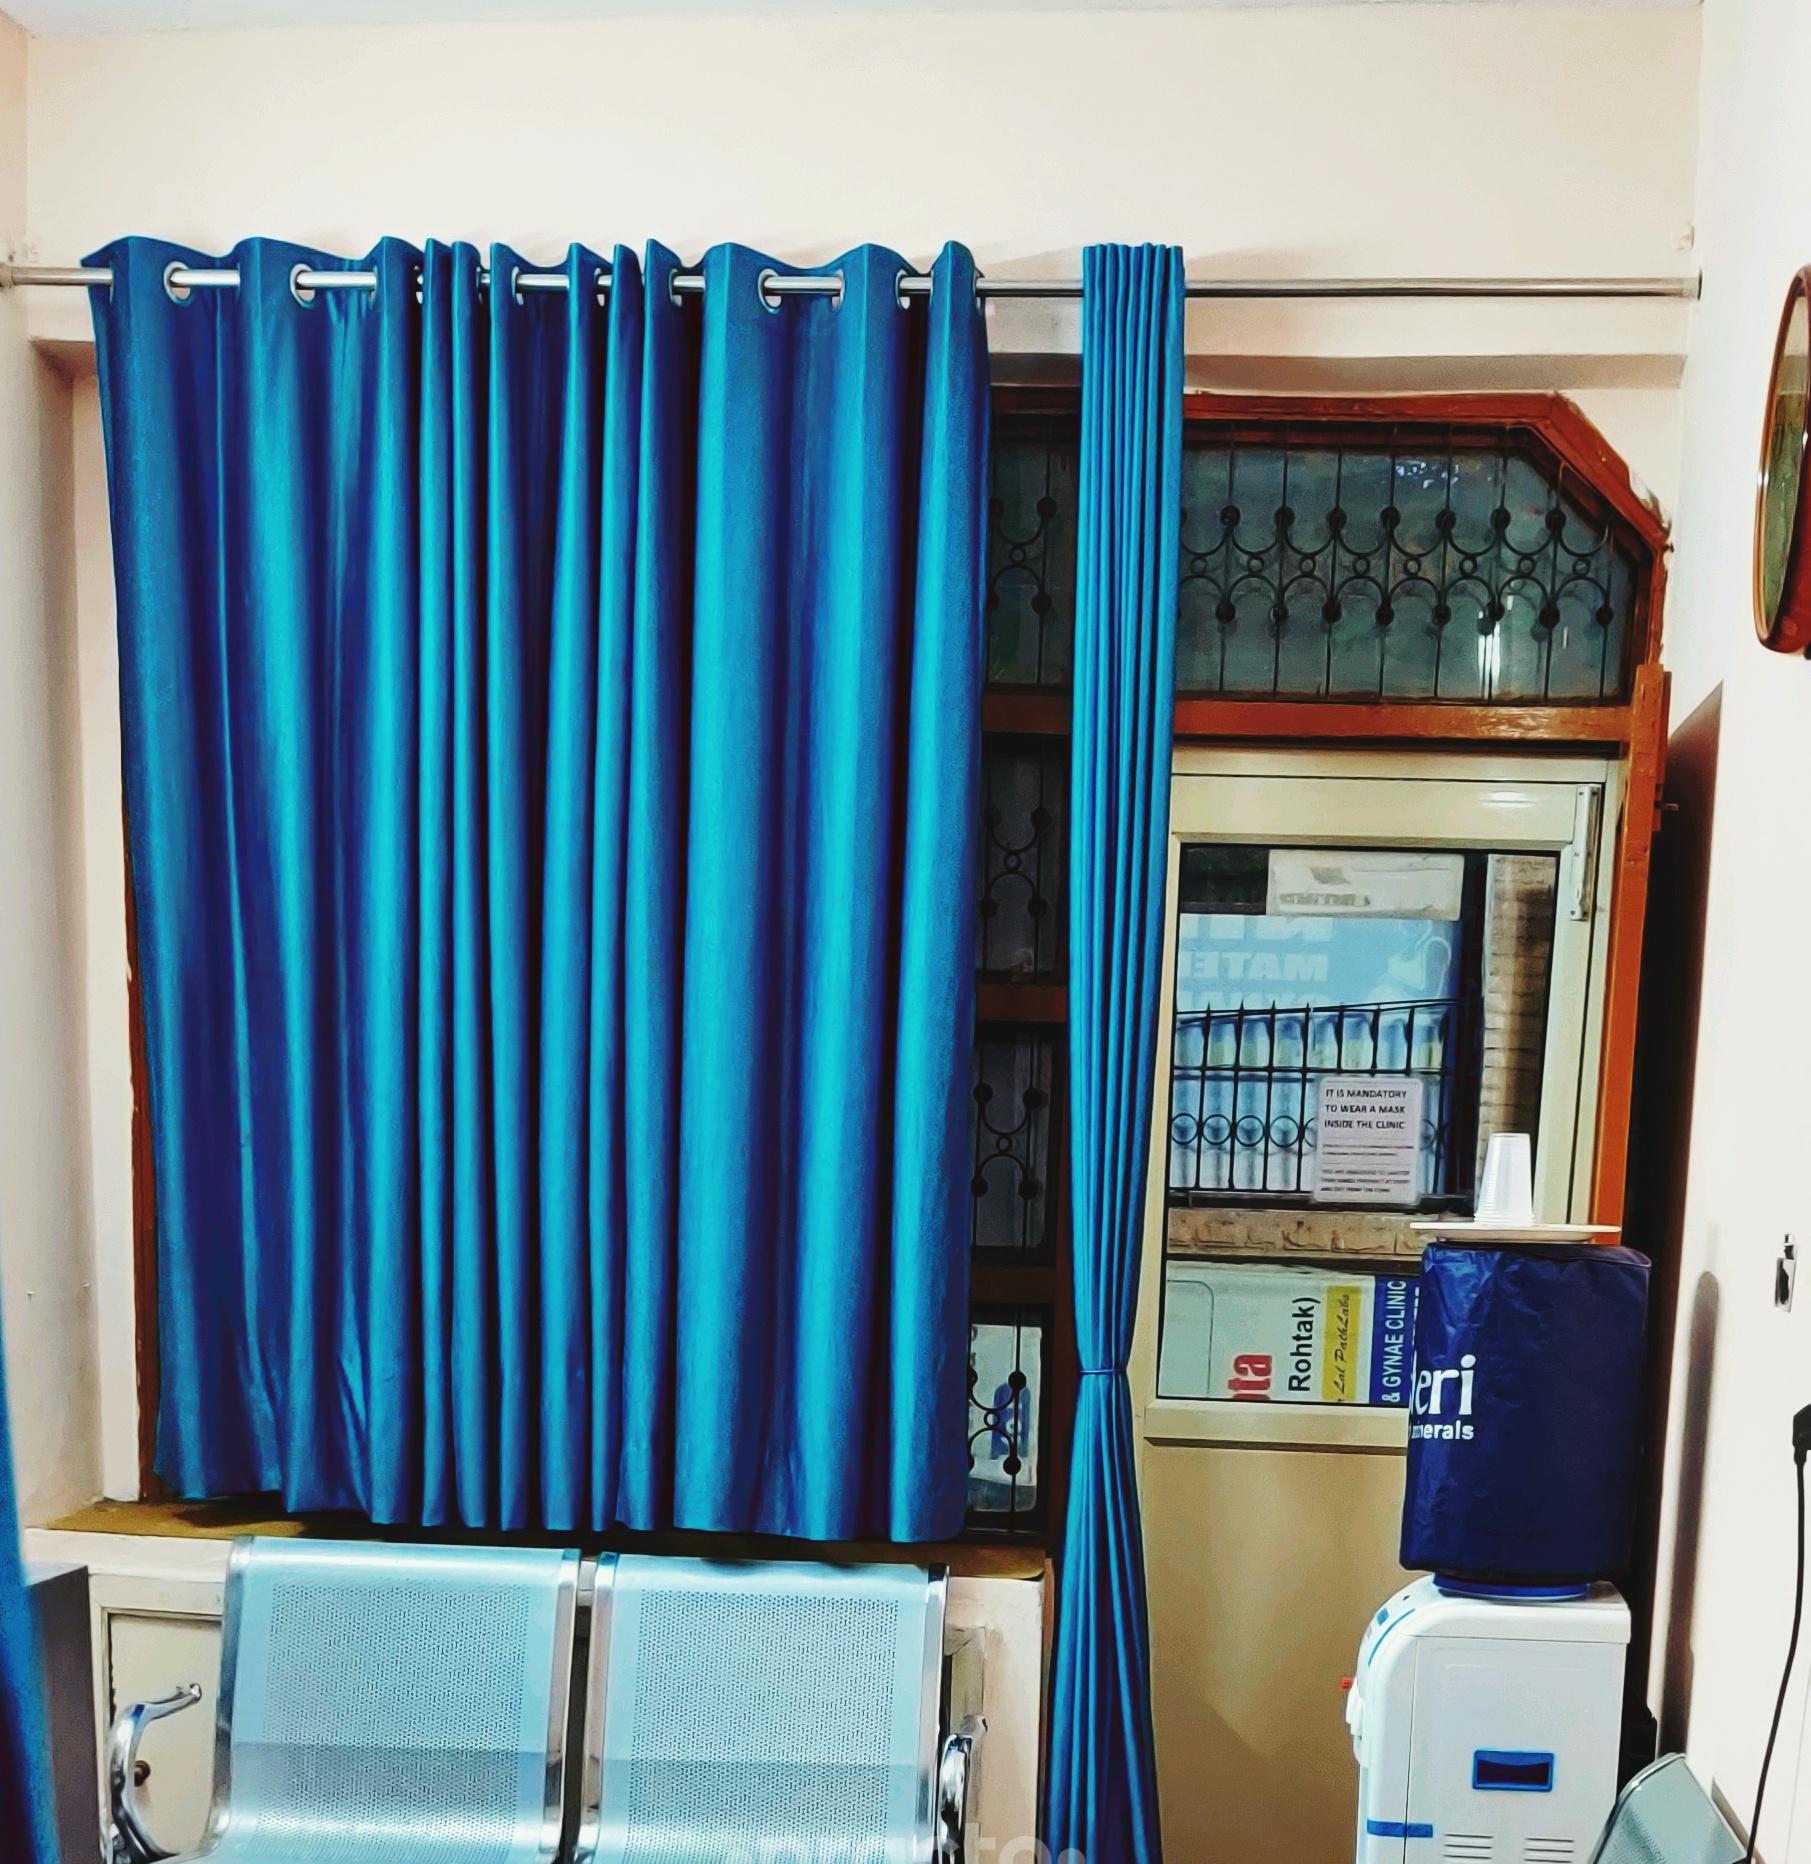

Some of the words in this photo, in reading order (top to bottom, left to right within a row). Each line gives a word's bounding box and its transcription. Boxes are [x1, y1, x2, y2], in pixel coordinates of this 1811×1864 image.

[1325, 1089, 1333, 1098] IT
[1336, 1089, 1344, 1098] IS
[1346, 1089, 1407, 1099] MANDATORY
[1325, 1104, 1338, 1113] TO
[1340, 1105, 1367, 1113] WEAR
[1369, 1105, 1376, 1113] A
[1378, 1105, 1406, 1114] MASK
[1324, 1119, 1353, 1128] INSIDE
[1357, 1120, 1373, 1128] THE
[1375, 1120, 1406, 1129] CLINIC
[1385, 1279, 1407, 1331] CLINIC
[1288, 1296, 1321, 1392] Rohtak)
[1382, 1333, 1403, 1389] GYNAE
[1332, 1366, 1346, 1396] Lal
[1381, 1392, 1401, 1403] &
